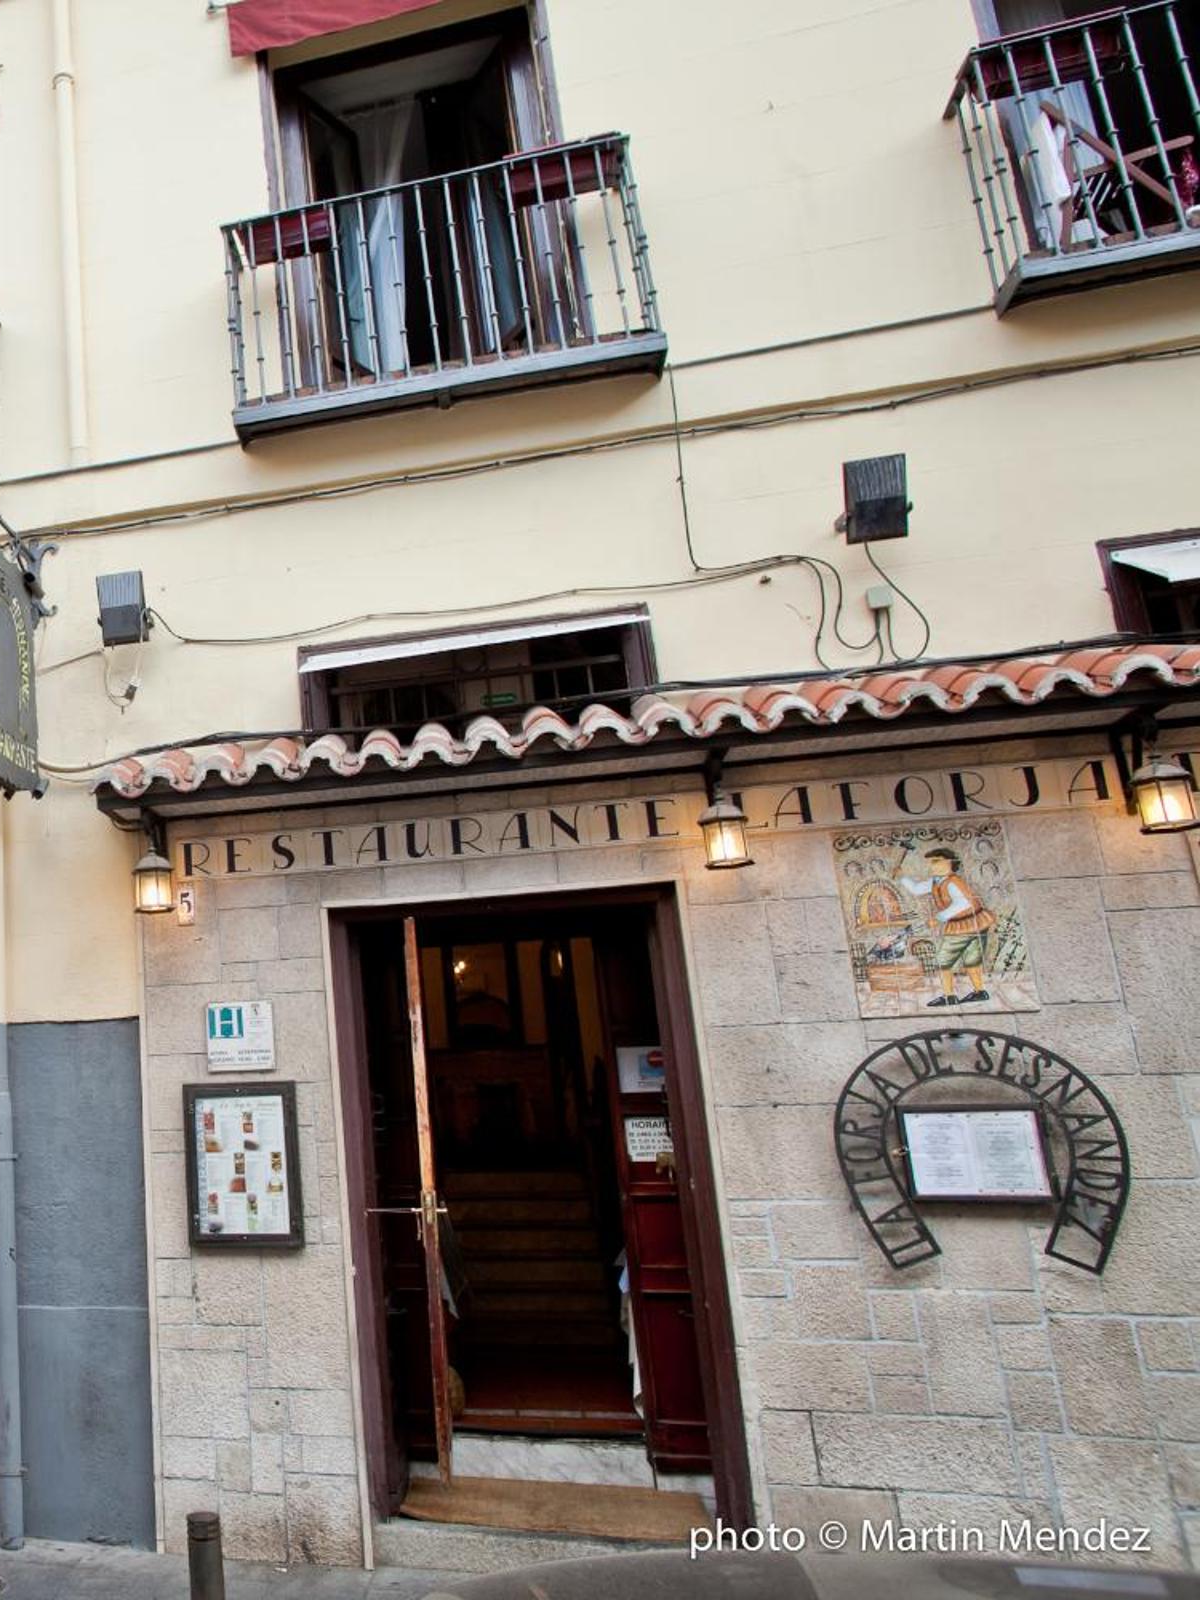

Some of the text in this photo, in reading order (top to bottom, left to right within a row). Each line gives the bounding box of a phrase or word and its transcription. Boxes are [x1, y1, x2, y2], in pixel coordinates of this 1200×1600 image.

[183, 799, 680, 877] RESTAURANTE
[832, 760, 1110, 821] FORJA
[180, 892, 191, 913] 5
[839, 1069, 905, 1184] FORJA
[898, 1034, 953, 1081] DE
